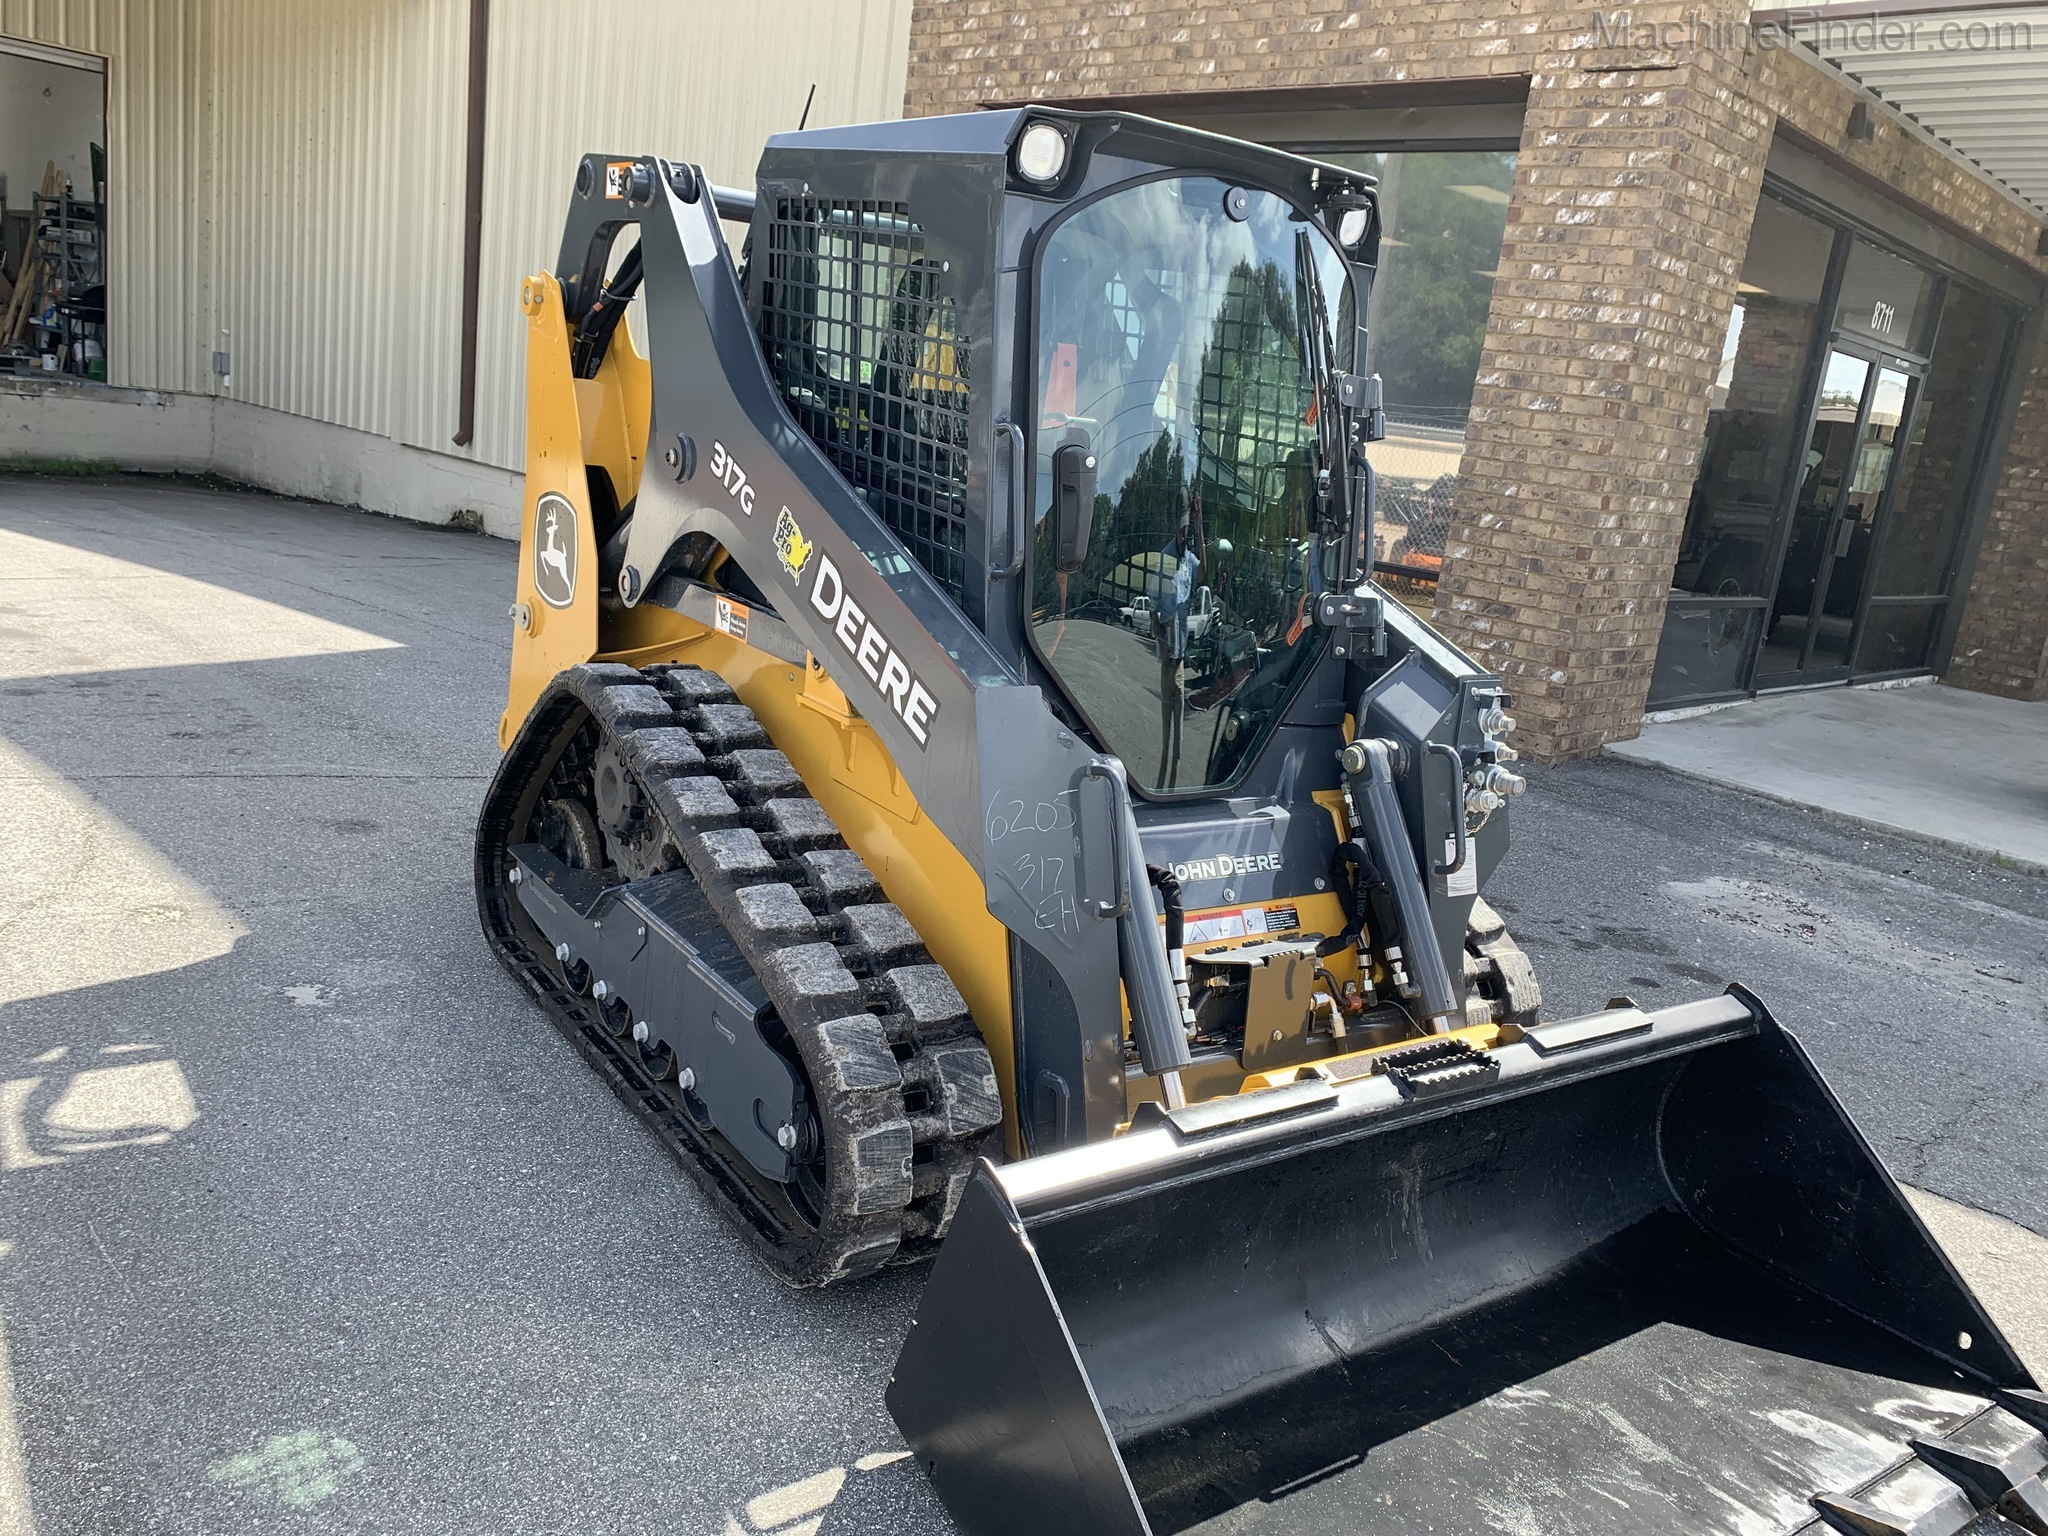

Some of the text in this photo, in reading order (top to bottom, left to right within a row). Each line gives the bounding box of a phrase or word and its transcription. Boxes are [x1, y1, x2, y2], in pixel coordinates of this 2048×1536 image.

[1871, 300, 1895, 334] 8711
[709, 440, 756, 516] 317G
[776, 528, 792, 555] Pro
[810, 553, 937, 745] DEERE
[986, 788, 1079, 846] 6205
[1013, 853, 1064, 893] 317
[1217, 853, 1282, 876] DEERE
